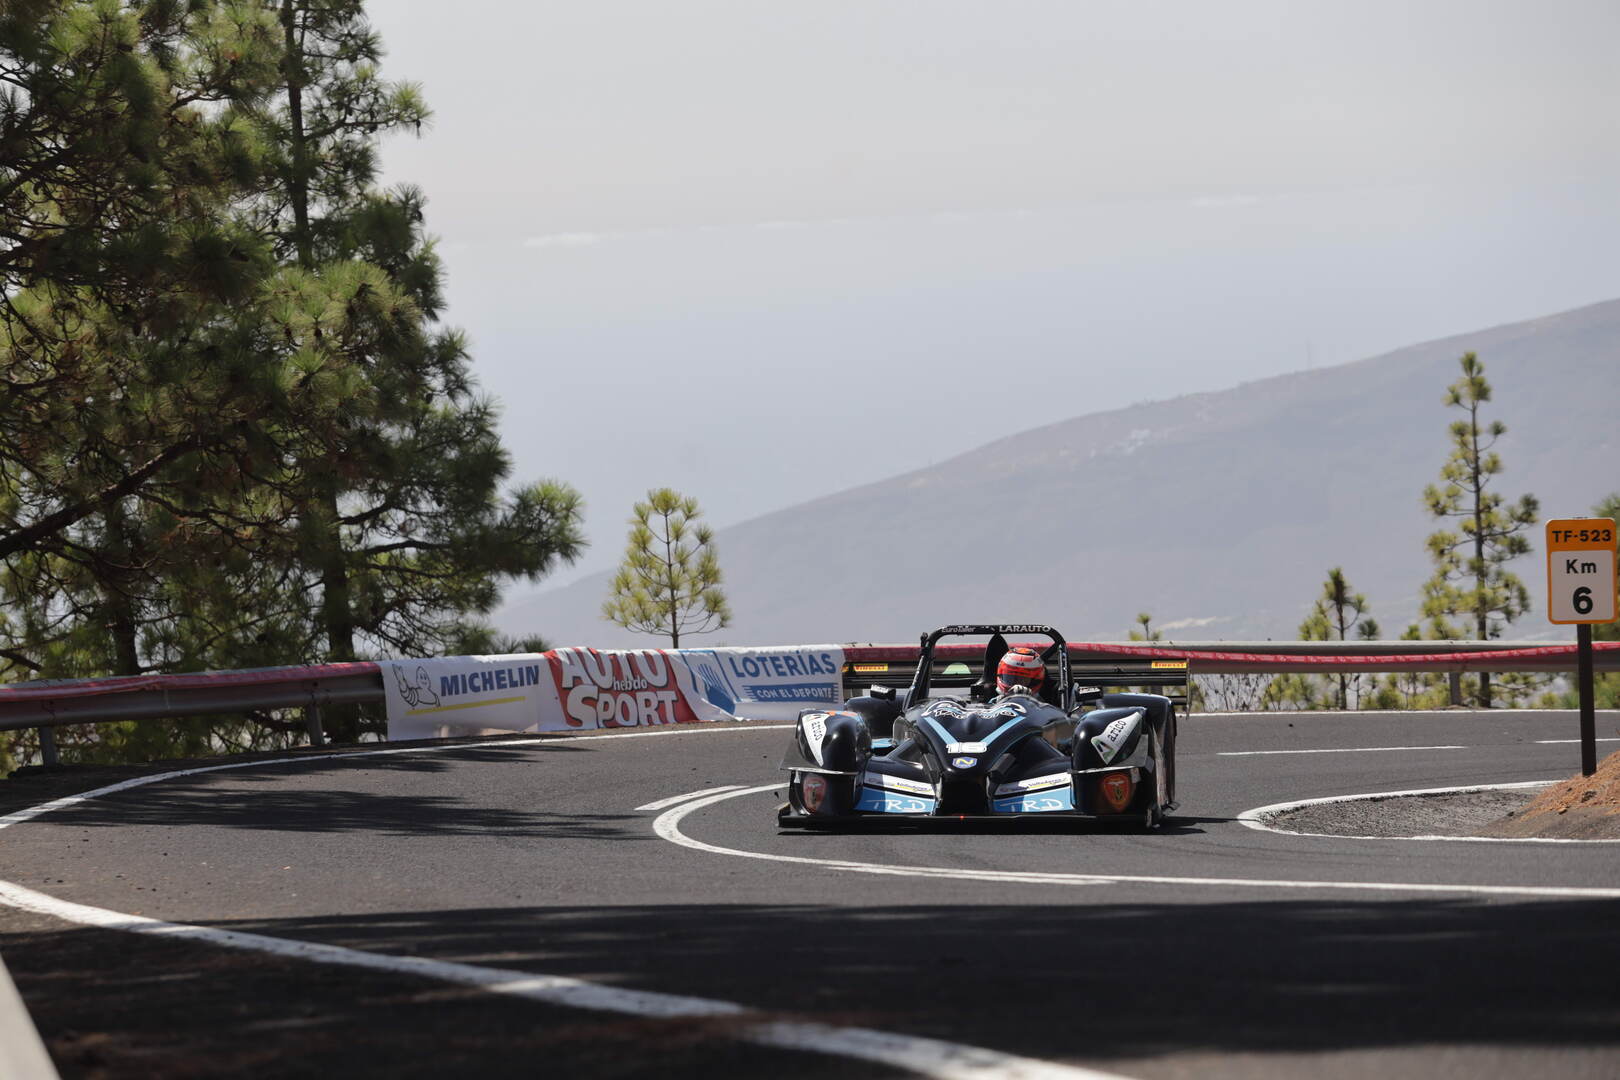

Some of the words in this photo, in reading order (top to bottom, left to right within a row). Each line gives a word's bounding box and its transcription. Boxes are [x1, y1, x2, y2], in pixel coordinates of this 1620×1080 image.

[1551, 529, 1612, 543] TF-523
[1566, 559, 1597, 574] Km
[1572, 586, 1594, 615] 6
[999, 625, 1051, 633] LARAUTO
[559, 648, 669, 690] AUTO
[728, 650, 837, 678] LOTERÍAS
[440, 664, 540, 697] MICHELIN
[612, 675, 648, 691] hebdo
[756, 689, 778, 699] CON
[780, 689, 793, 699] EL
[794, 687, 833, 699] DEPORTE
[566, 684, 678, 730] SPORT
[1107, 719, 1127, 742] arico
